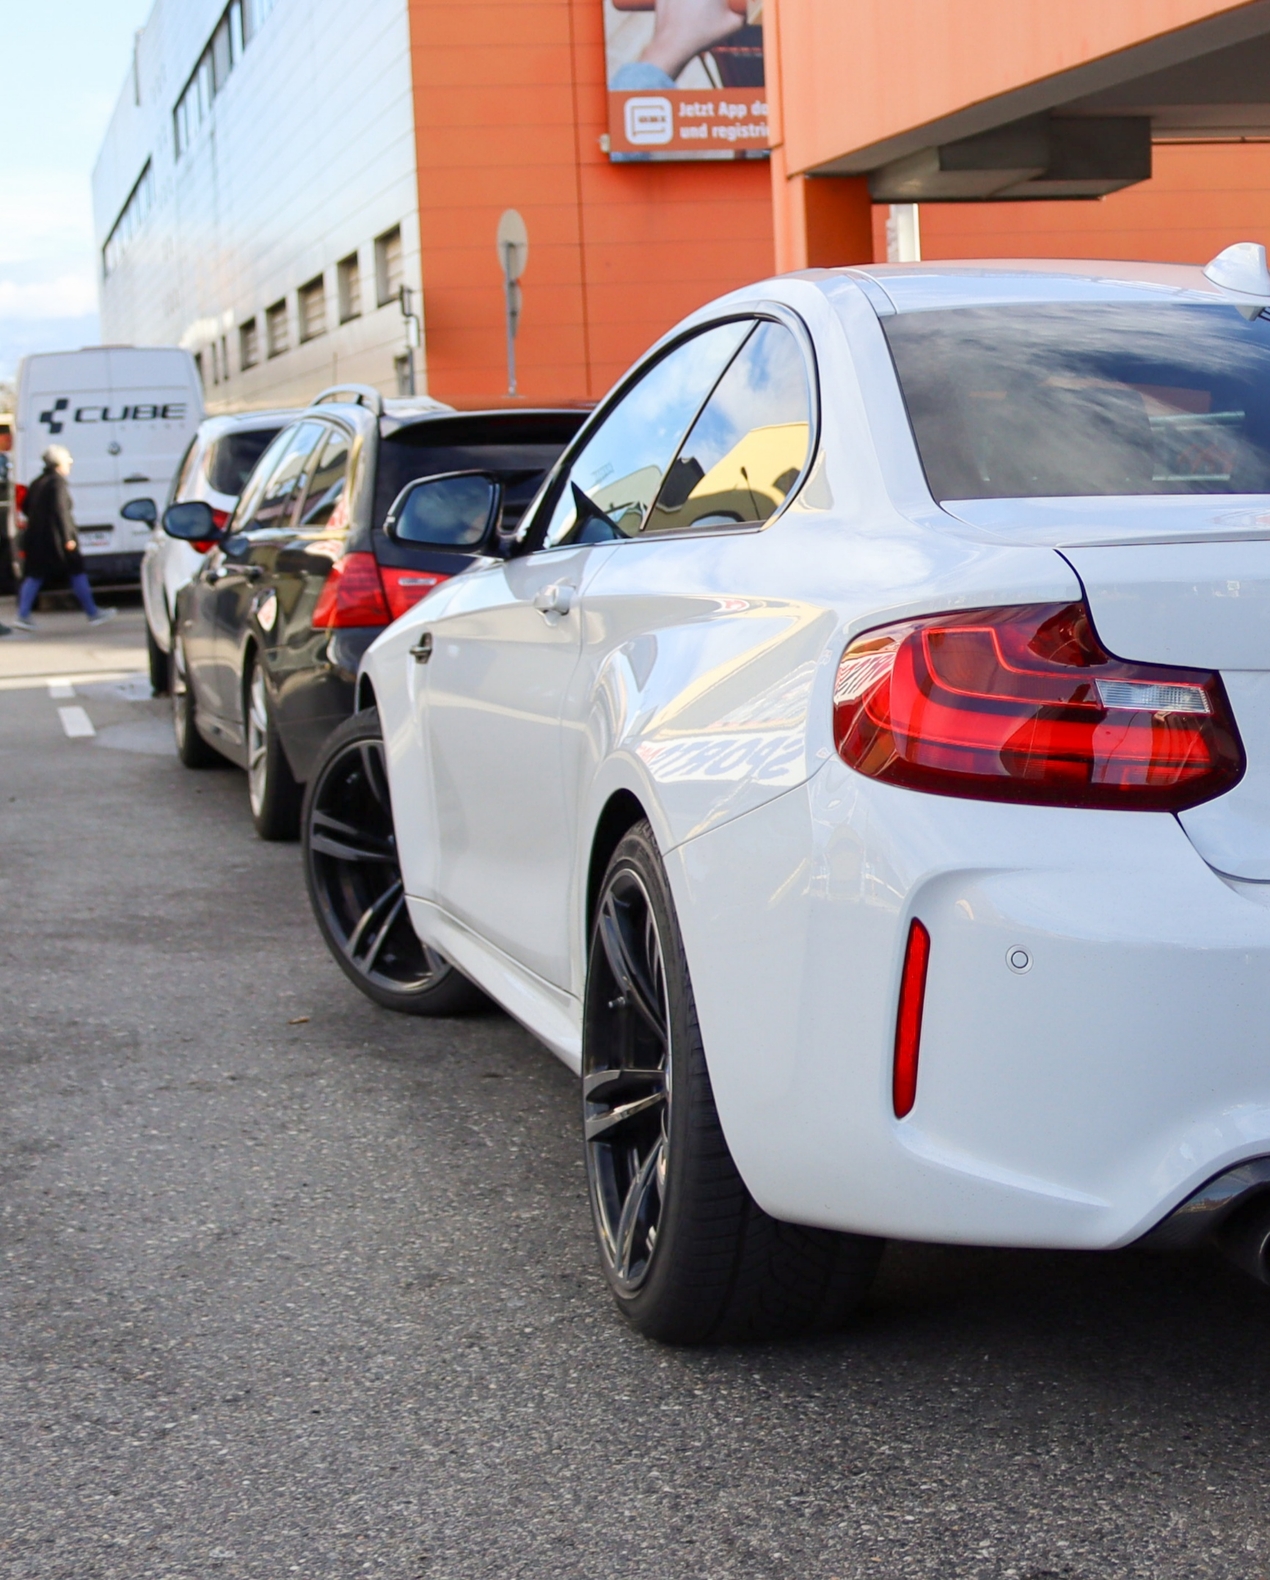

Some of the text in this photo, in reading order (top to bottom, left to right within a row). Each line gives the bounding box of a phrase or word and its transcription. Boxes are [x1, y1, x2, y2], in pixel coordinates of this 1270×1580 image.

[679, 102, 714, 117] Jetzt
[718, 101, 747, 119] App
[680, 123, 708, 139] und
[74, 403, 187, 423] CUBE
